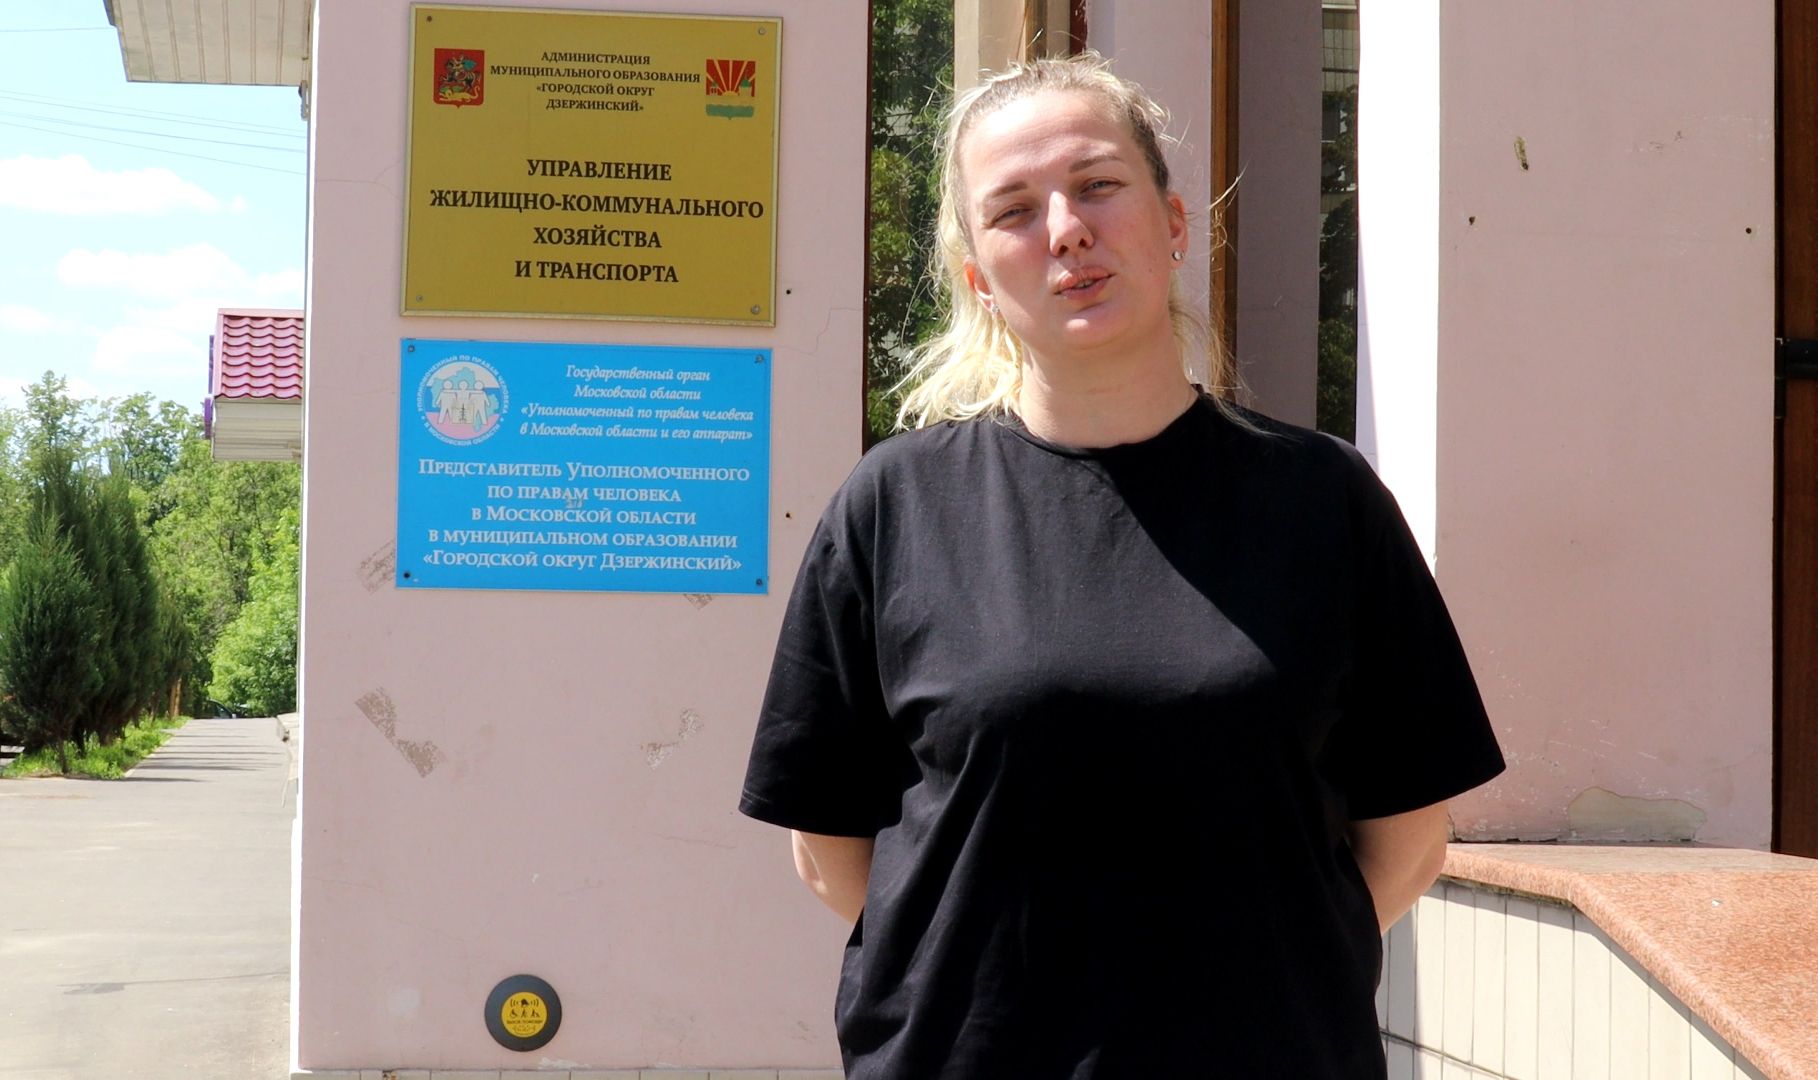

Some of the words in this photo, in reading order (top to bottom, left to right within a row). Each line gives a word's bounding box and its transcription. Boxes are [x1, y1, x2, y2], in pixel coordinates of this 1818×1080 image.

[541, 51, 650, 66] АДМИНИСТРАЦИЯ
[490, 65, 611, 80] МУНИЦИПАЛЬНОГО
[613, 70, 700, 83] ОБРАЗОВАНИЯ
[536, 83, 614, 95] «ГОРОДСКОЙ
[617, 86, 655, 96] ОКРУГ
[546, 99, 644, 112] ДЗЕРЖИНСКИЙ»
[526, 159, 672, 181] УПРАВЛЕНИЕ
[429, 188, 763, 218] ЖИЛИЩНО-КОММУНАЛЬНОГО
[533, 225, 663, 248] ХОЗЯЙСТВА
[514, 260, 532, 278] И
[535, 260, 680, 284] ТРАНСПОРТА
[566, 364, 674, 382] Государственный
[676, 370, 711, 386] орган
[574, 384, 647, 399] Московской
[649, 386, 701, 401] области
[521, 403, 634, 419] «Уполномоченный
[637, 409, 653, 419] по
[655, 407, 700, 423] правам
[702, 407, 754, 421] человека
[519, 422, 529, 435] в
[529, 422, 604, 437] Московской
[605, 424, 658, 438] области
[660, 429, 669, 438] и
[671, 429, 691, 439] его
[692, 429, 753, 443] аппарат»
